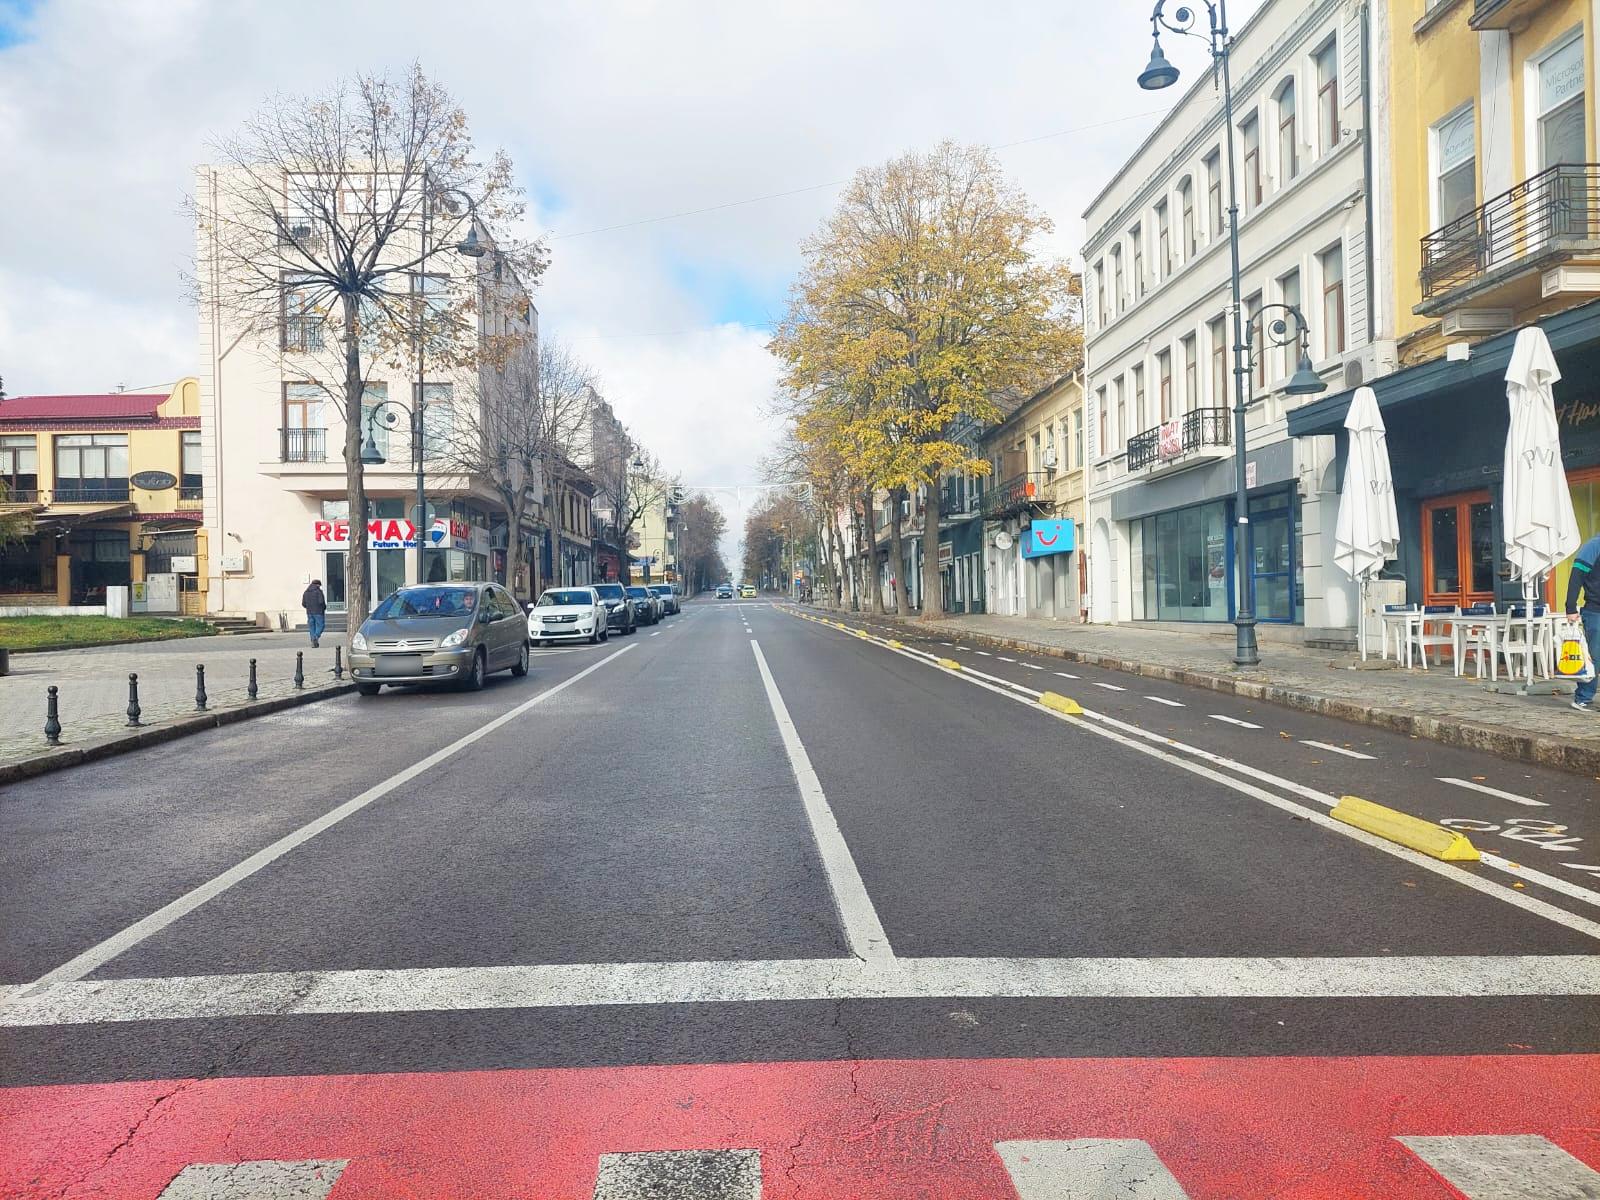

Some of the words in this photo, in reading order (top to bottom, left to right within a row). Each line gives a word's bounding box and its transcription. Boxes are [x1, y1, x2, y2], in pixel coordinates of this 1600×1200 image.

[1545, 55, 1585, 89] Microsof
[1555, 72, 1585, 97] Partne
[314, 519, 417, 542] REMAX
[373, 540, 400, 548] Future
